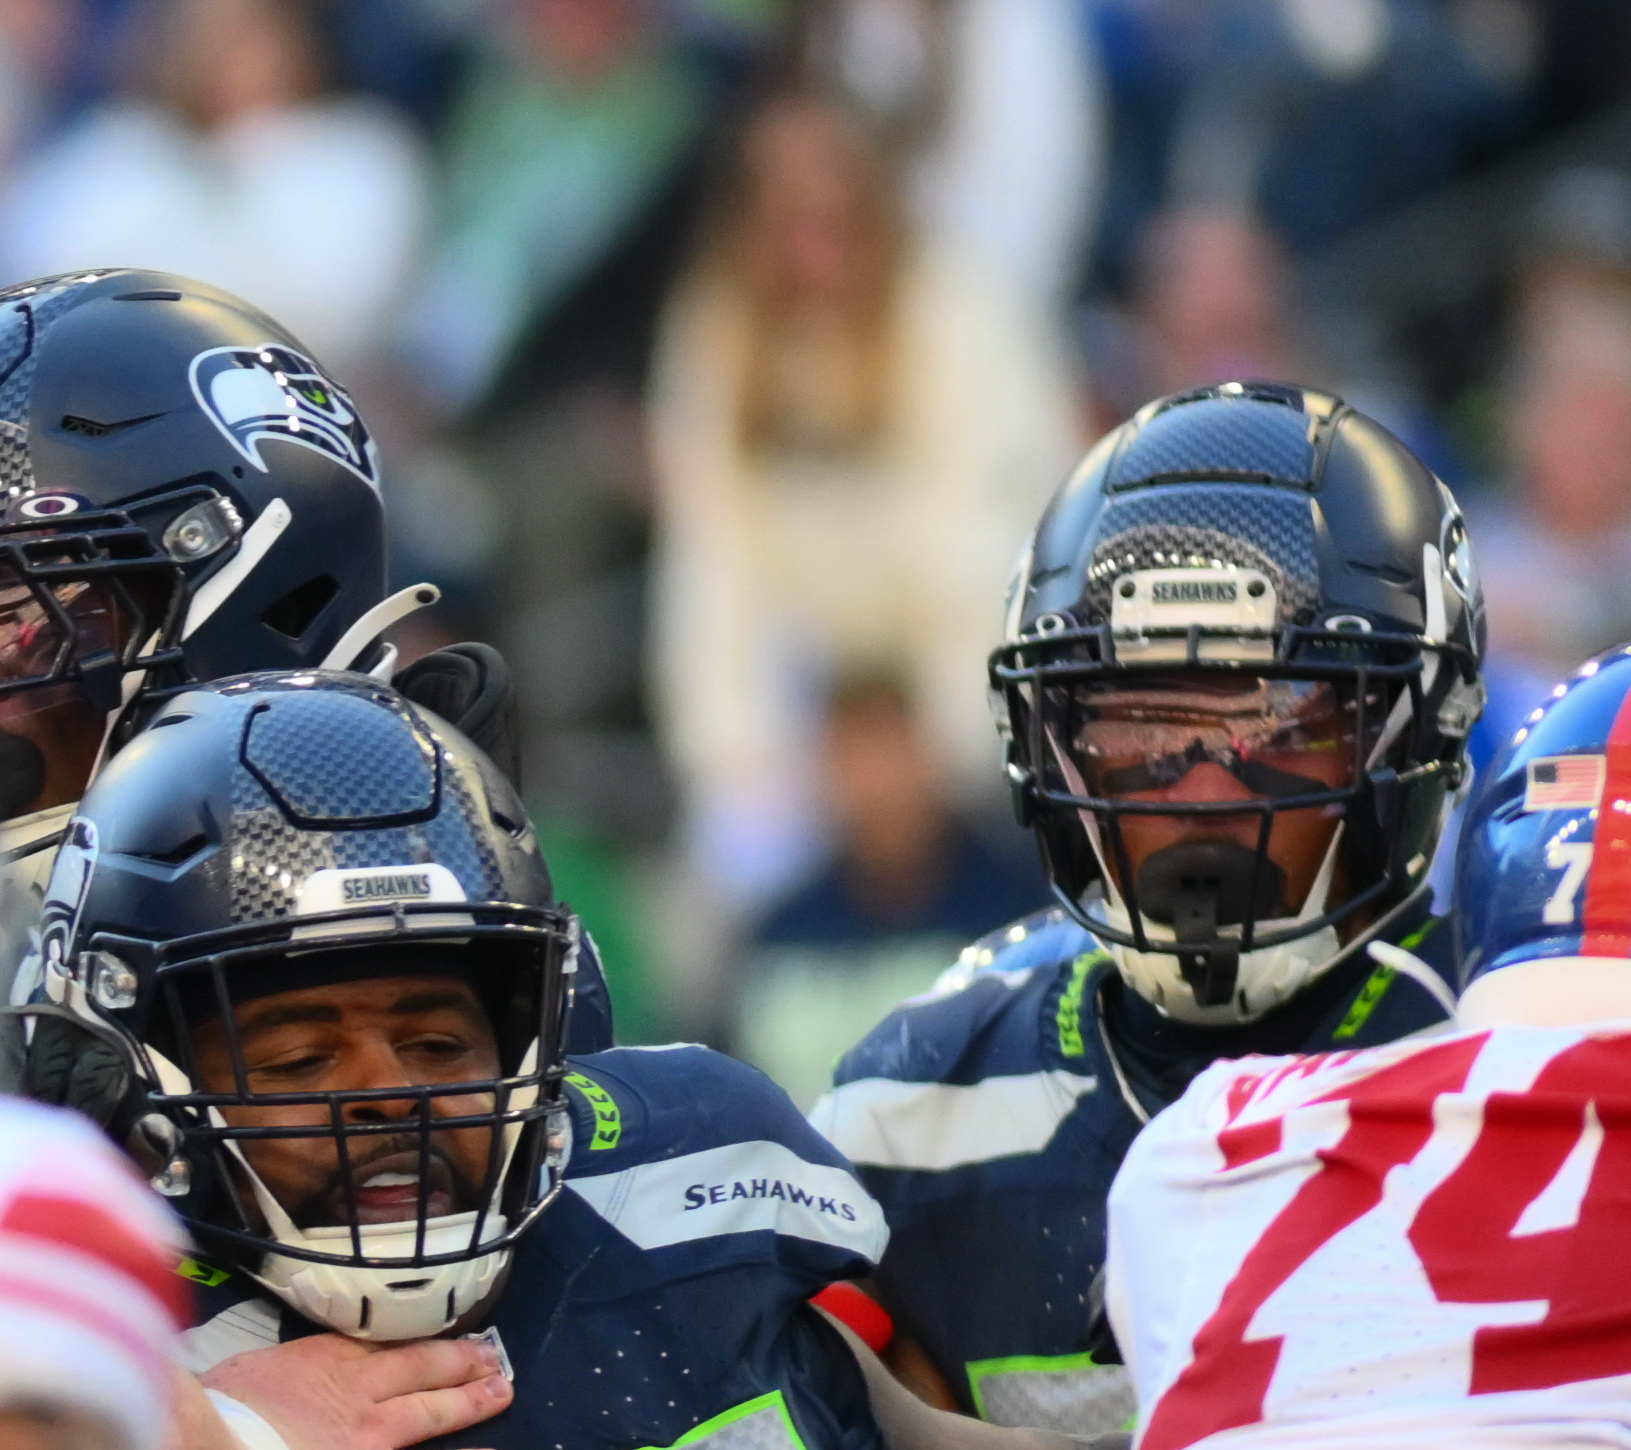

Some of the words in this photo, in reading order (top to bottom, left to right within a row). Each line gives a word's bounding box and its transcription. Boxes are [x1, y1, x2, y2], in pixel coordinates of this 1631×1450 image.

[344, 874, 430, 900] SEAHAWKS
[1545, 842, 1592, 923] 7
[684, 1178, 856, 1221] SEAHAWKS
